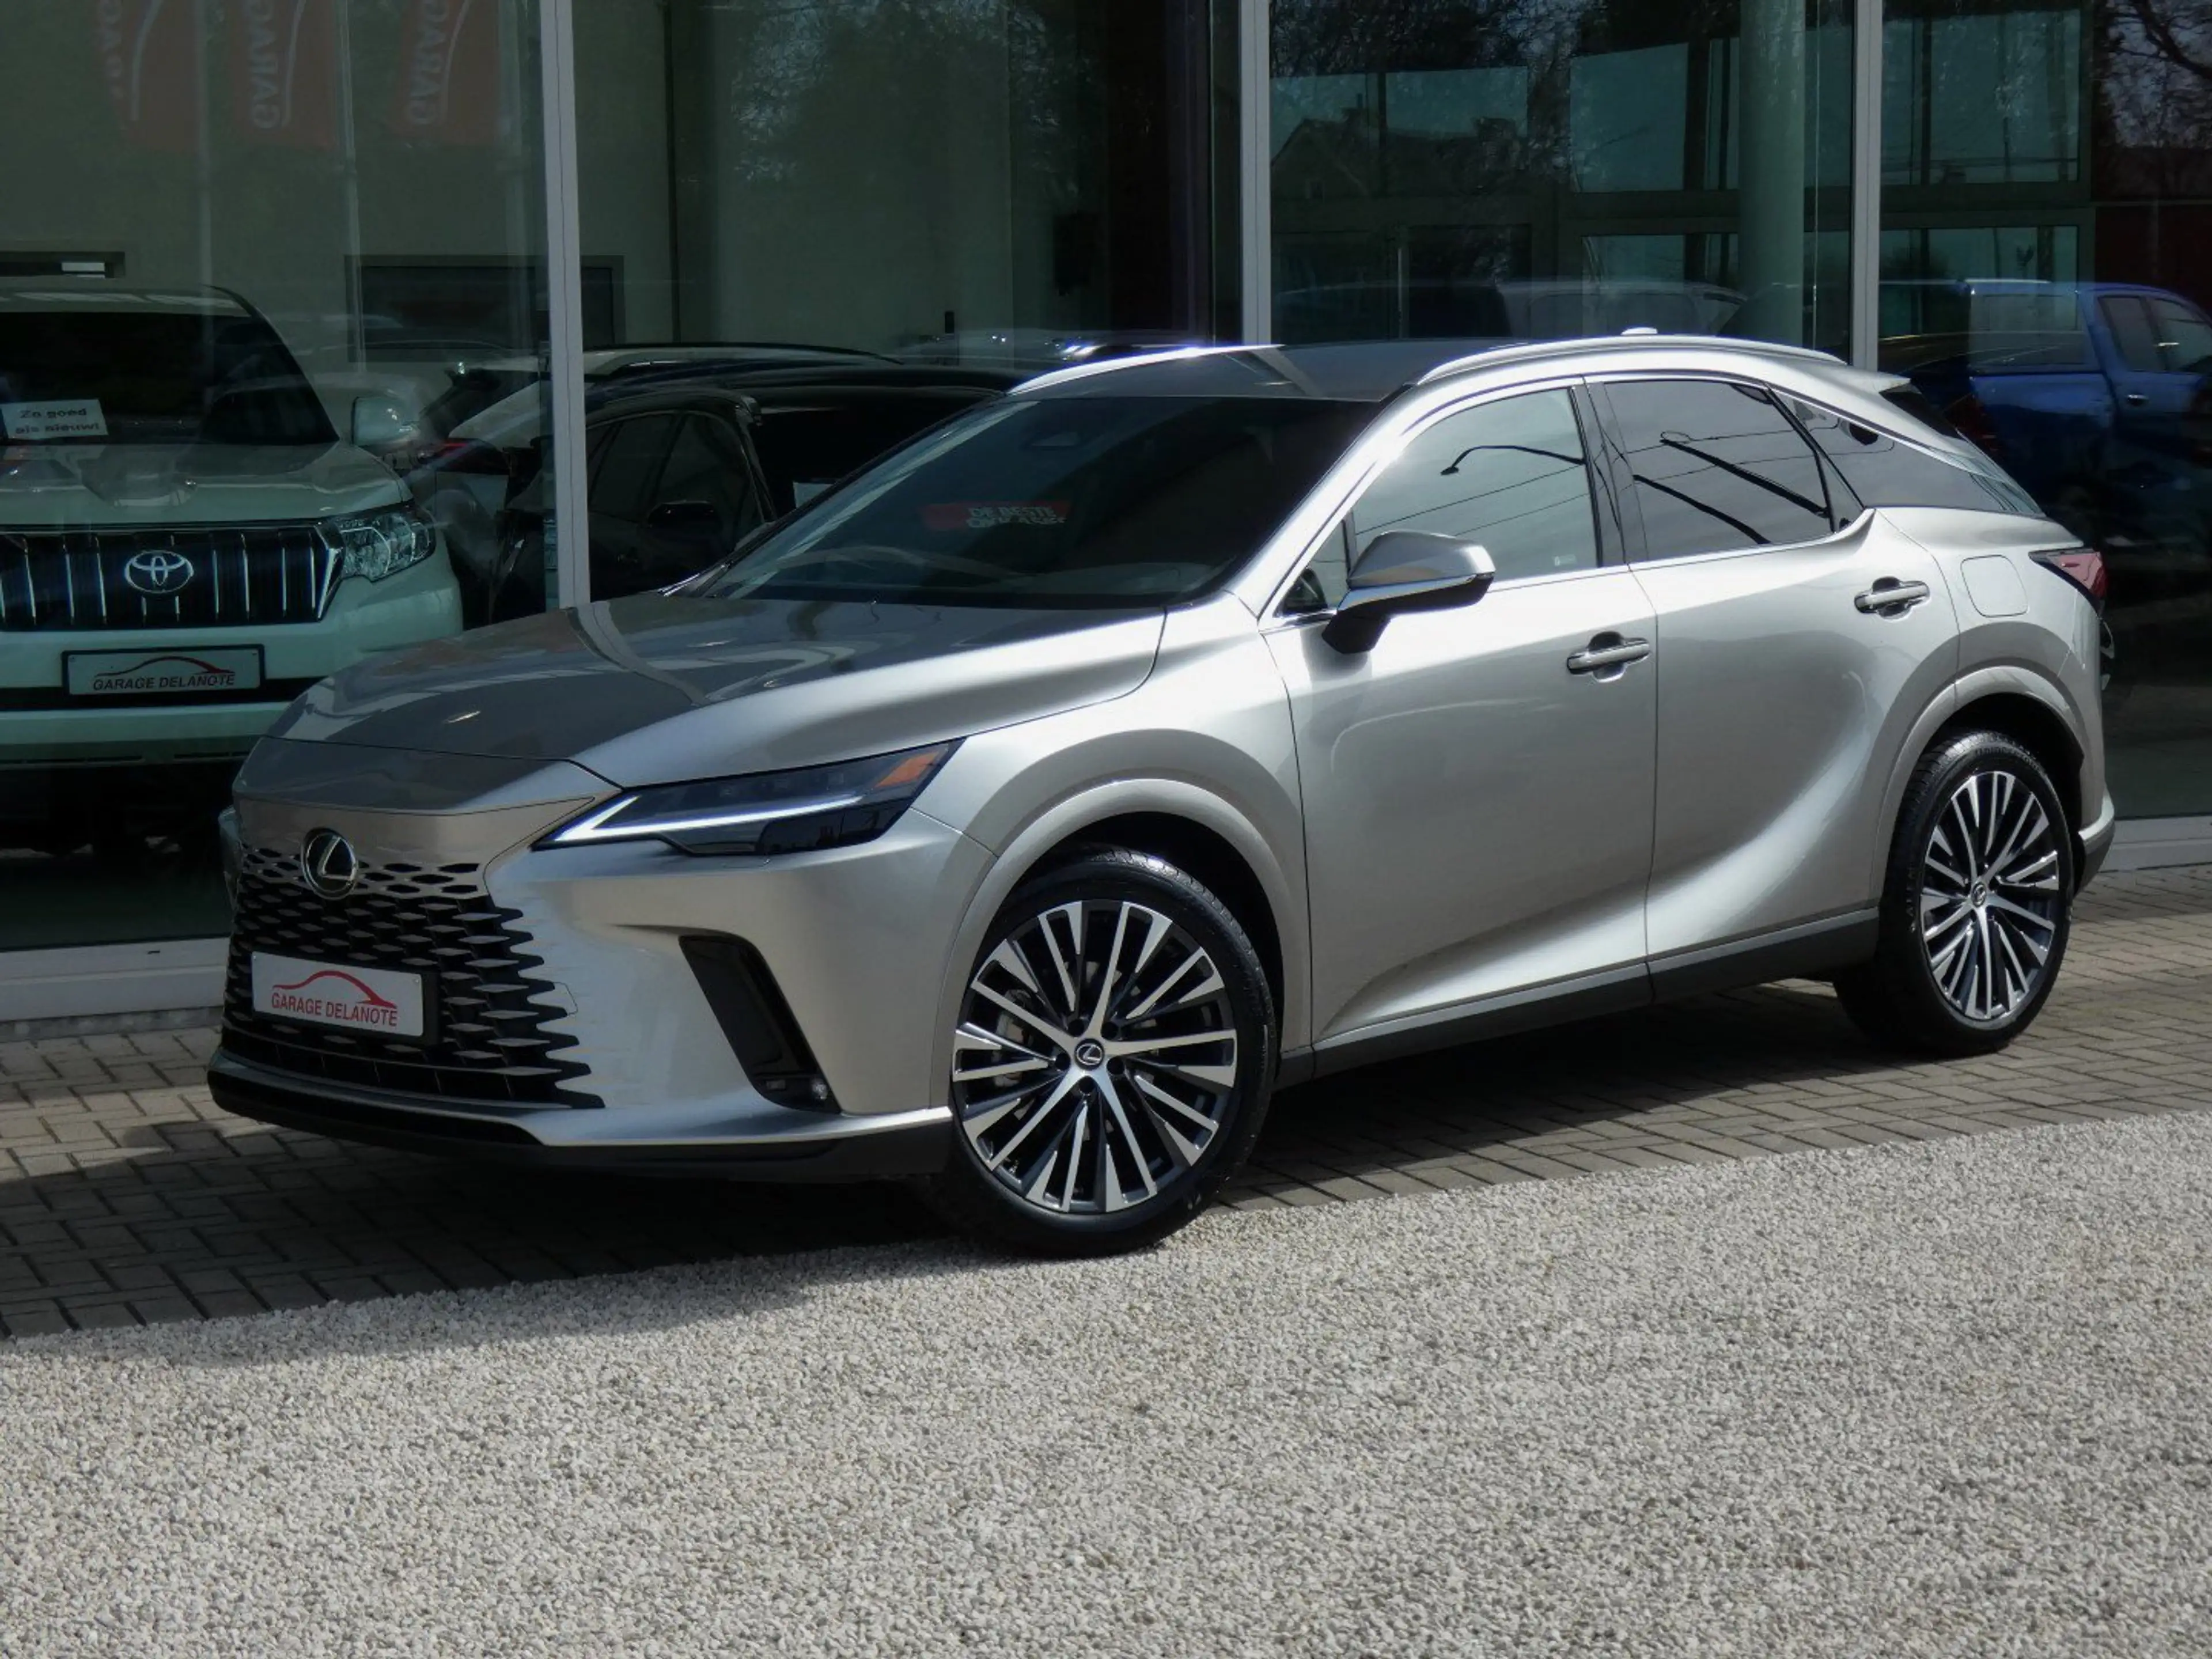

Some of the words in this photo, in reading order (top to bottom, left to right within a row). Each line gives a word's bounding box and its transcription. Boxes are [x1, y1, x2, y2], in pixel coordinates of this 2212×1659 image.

[93, 677, 154, 690] GARAGE
[160, 675, 234, 687] DELANOTE
[271, 993, 321, 1016] GARAGE
[326, 1002, 397, 1027] DELANOTE
